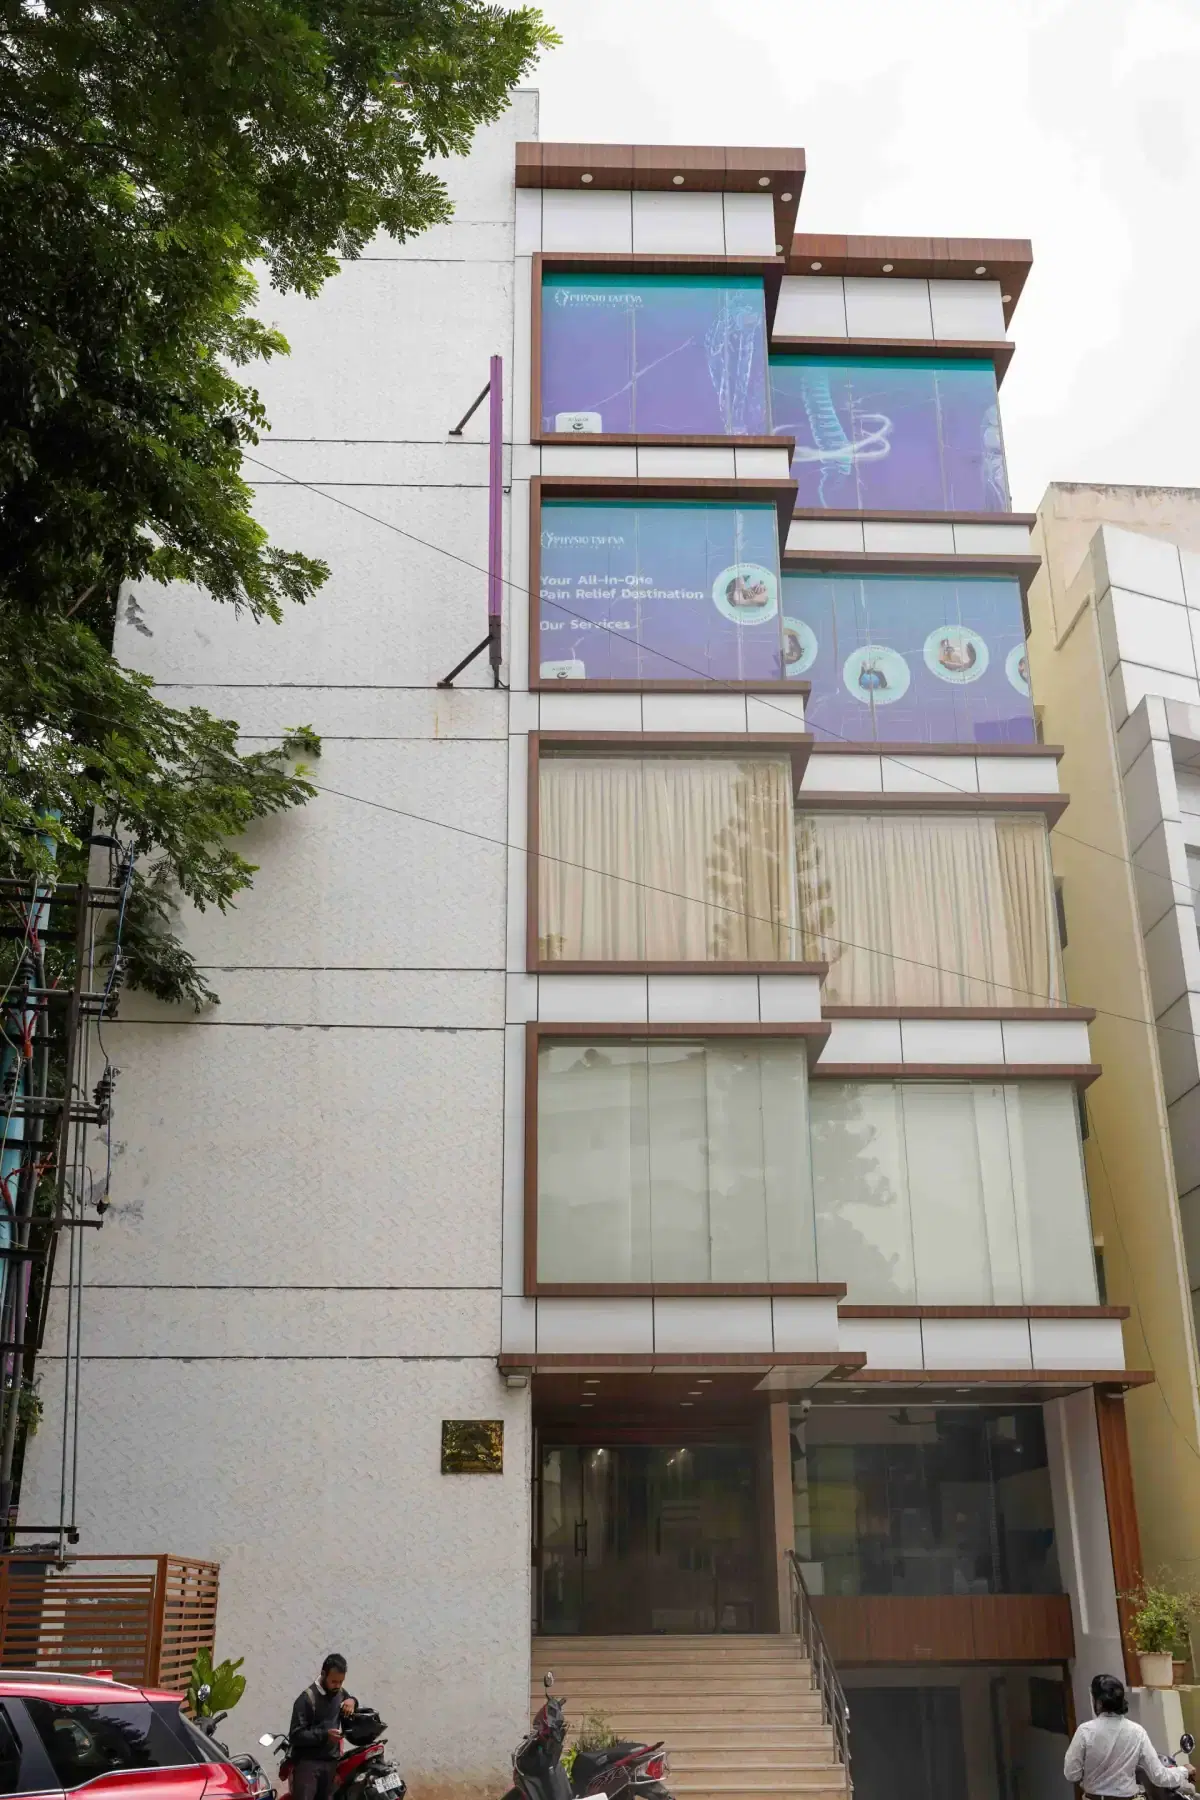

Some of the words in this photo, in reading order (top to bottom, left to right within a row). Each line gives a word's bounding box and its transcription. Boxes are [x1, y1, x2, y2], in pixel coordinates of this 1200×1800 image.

[540, 575, 572, 585] Your
[577, 575, 653, 585] All-In-One
[540, 589, 570, 600] Pain
[576, 588, 616, 599] Relief
[621, 588, 704, 599] Destination
[540, 620, 565, 631] Our
[570, 619, 631, 630] Services
